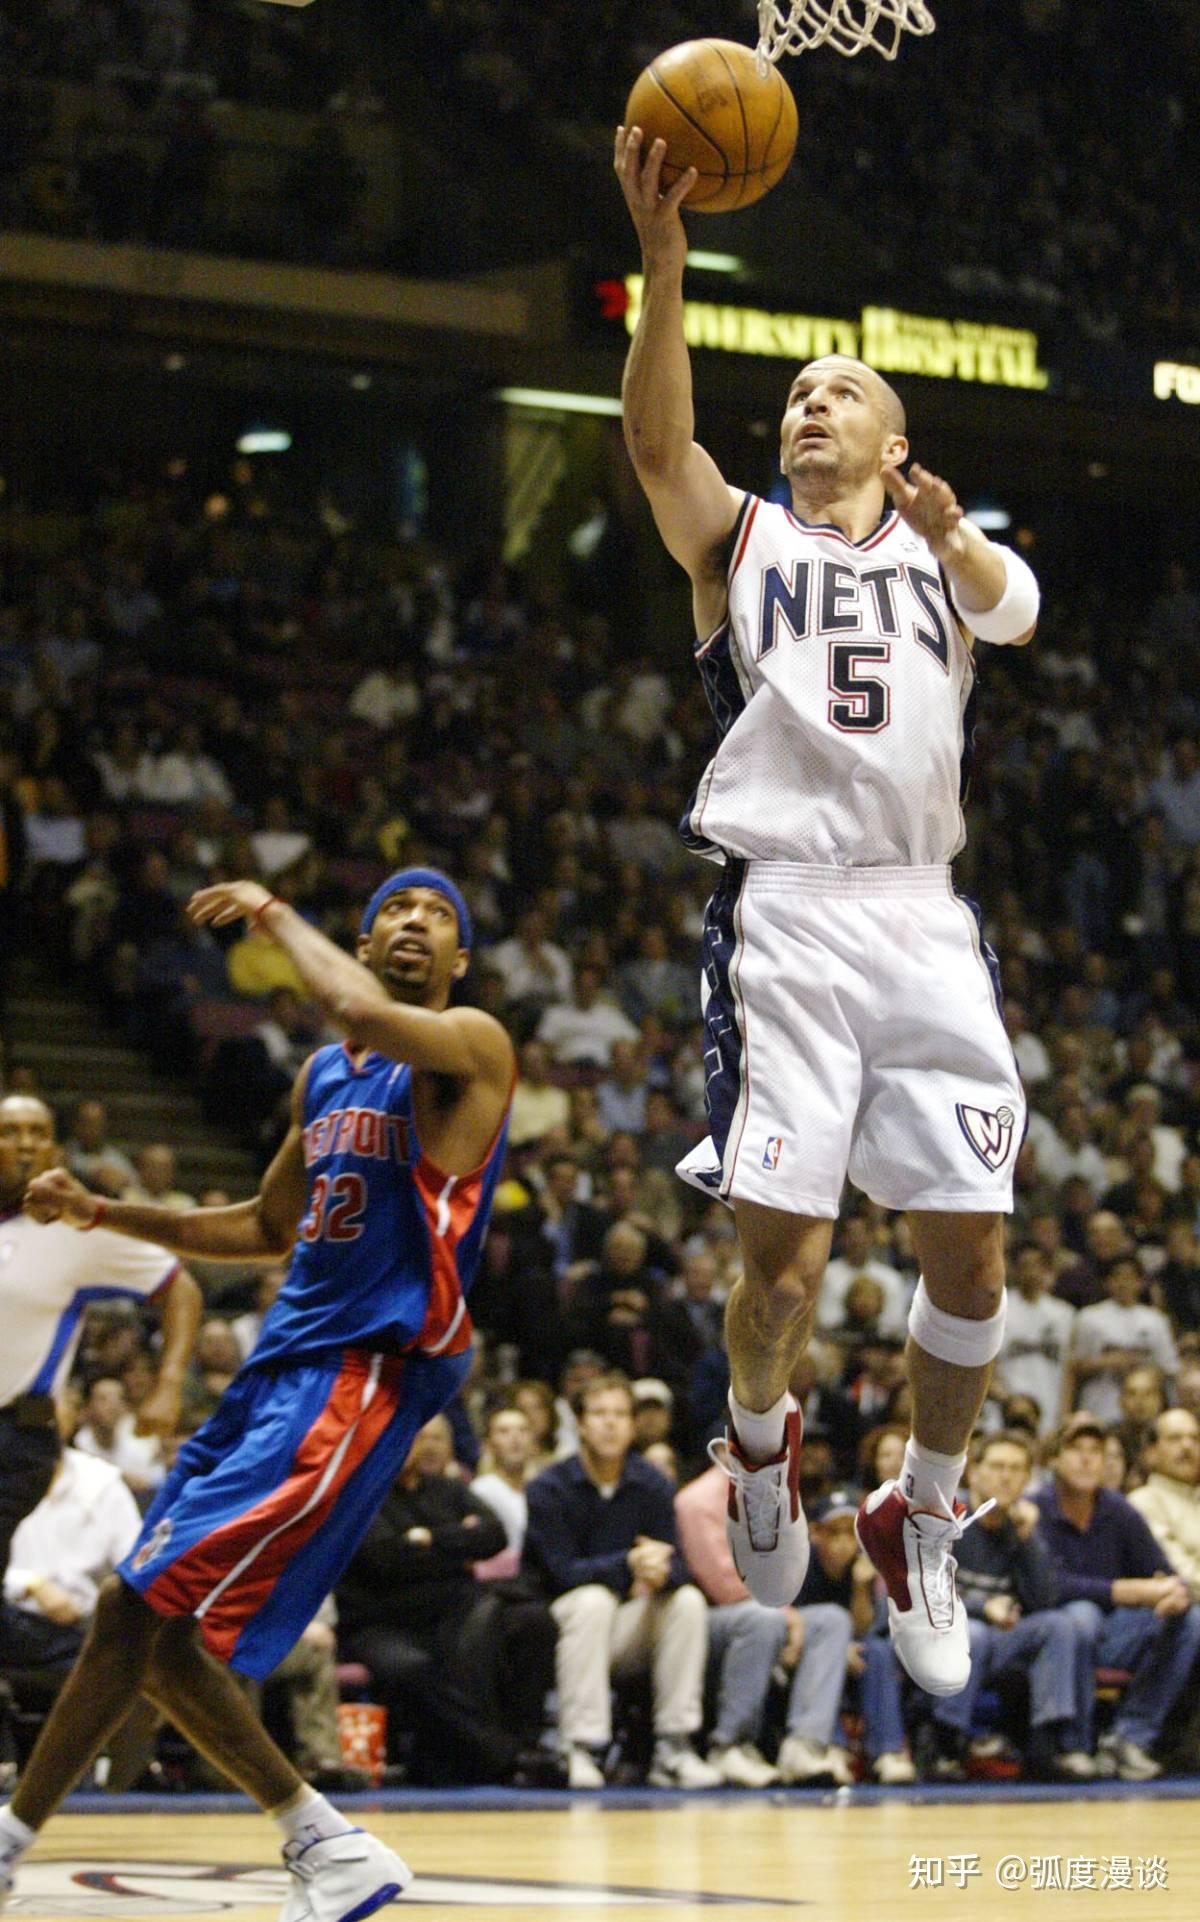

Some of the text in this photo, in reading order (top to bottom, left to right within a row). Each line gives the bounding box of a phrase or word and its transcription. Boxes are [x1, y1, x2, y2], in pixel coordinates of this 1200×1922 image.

[757, 559, 950, 676] NETS
[828, 641, 891, 733] 5
[301, 1173, 367, 1242] 32
